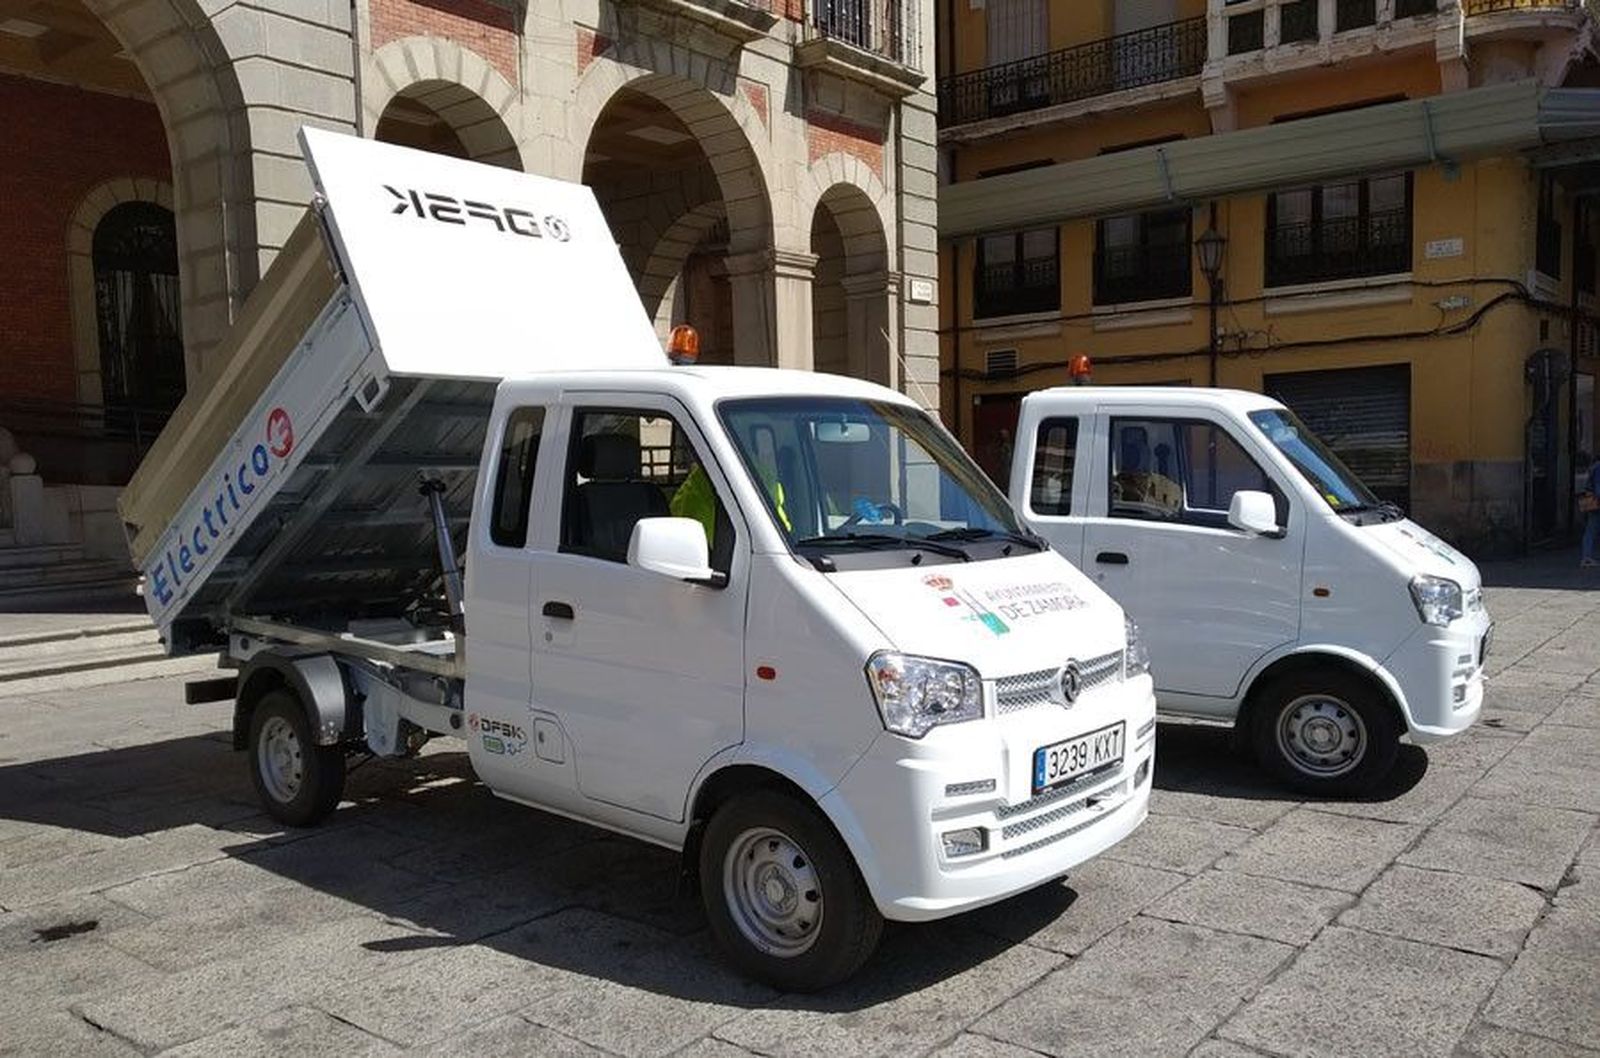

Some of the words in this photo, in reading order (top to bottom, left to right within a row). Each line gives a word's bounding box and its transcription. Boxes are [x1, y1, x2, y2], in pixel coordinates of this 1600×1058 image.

[152, 443, 269, 606] Eléctrico
[480, 718, 524, 739] DFSK
[1049, 741, 1088, 779] 3239
[1093, 729, 1120, 763] KXT
